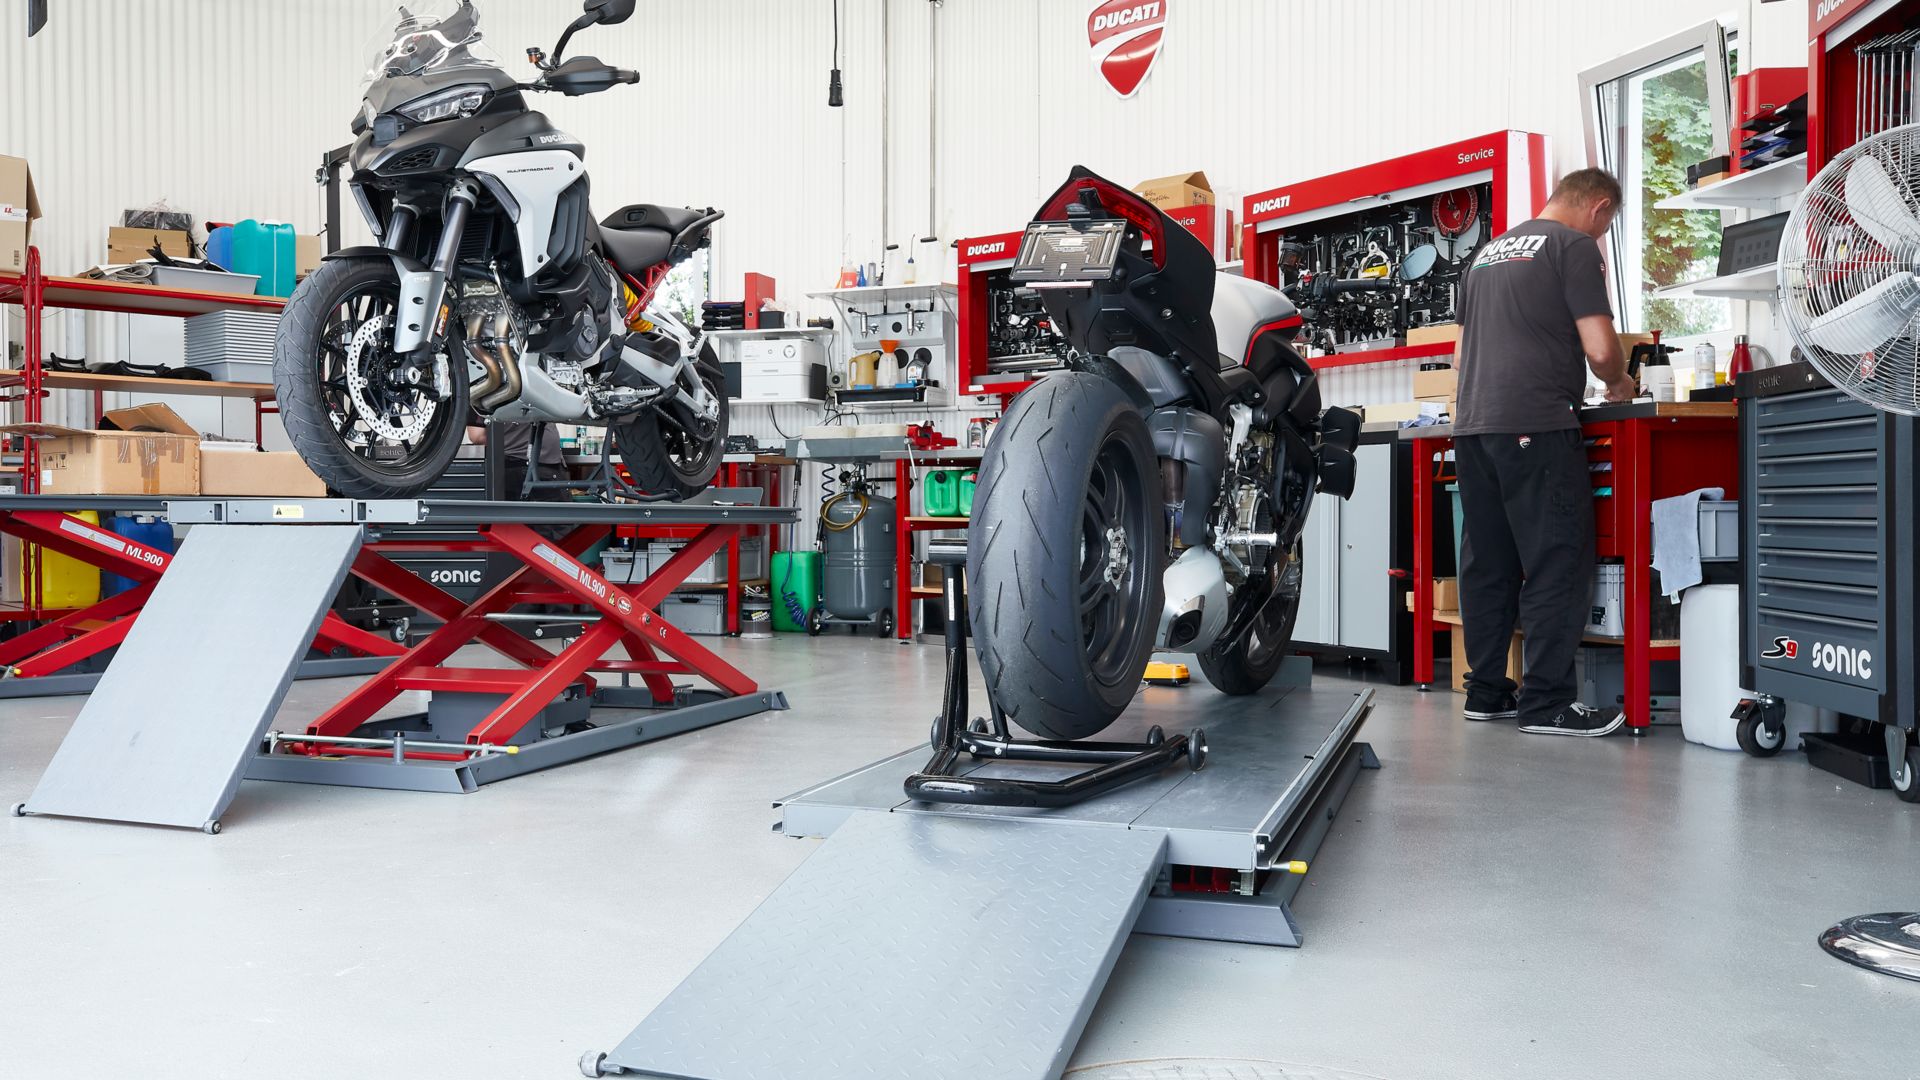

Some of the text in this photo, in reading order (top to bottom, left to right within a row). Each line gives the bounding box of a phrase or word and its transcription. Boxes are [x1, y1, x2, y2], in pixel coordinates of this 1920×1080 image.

[1093, 1, 1160, 32] DUCATI
[1457, 148, 1494, 165] Service
[1252, 194, 1291, 215] DUCATI
[967, 241, 1006, 257] DUCATI
[1476, 235, 1548, 260] DUCATI
[125, 544, 164, 567] ML900
[430, 569, 482, 584] SONIC
[579, 569, 606, 599] ML900
[1761, 636, 1872, 680] S9 SONIC
